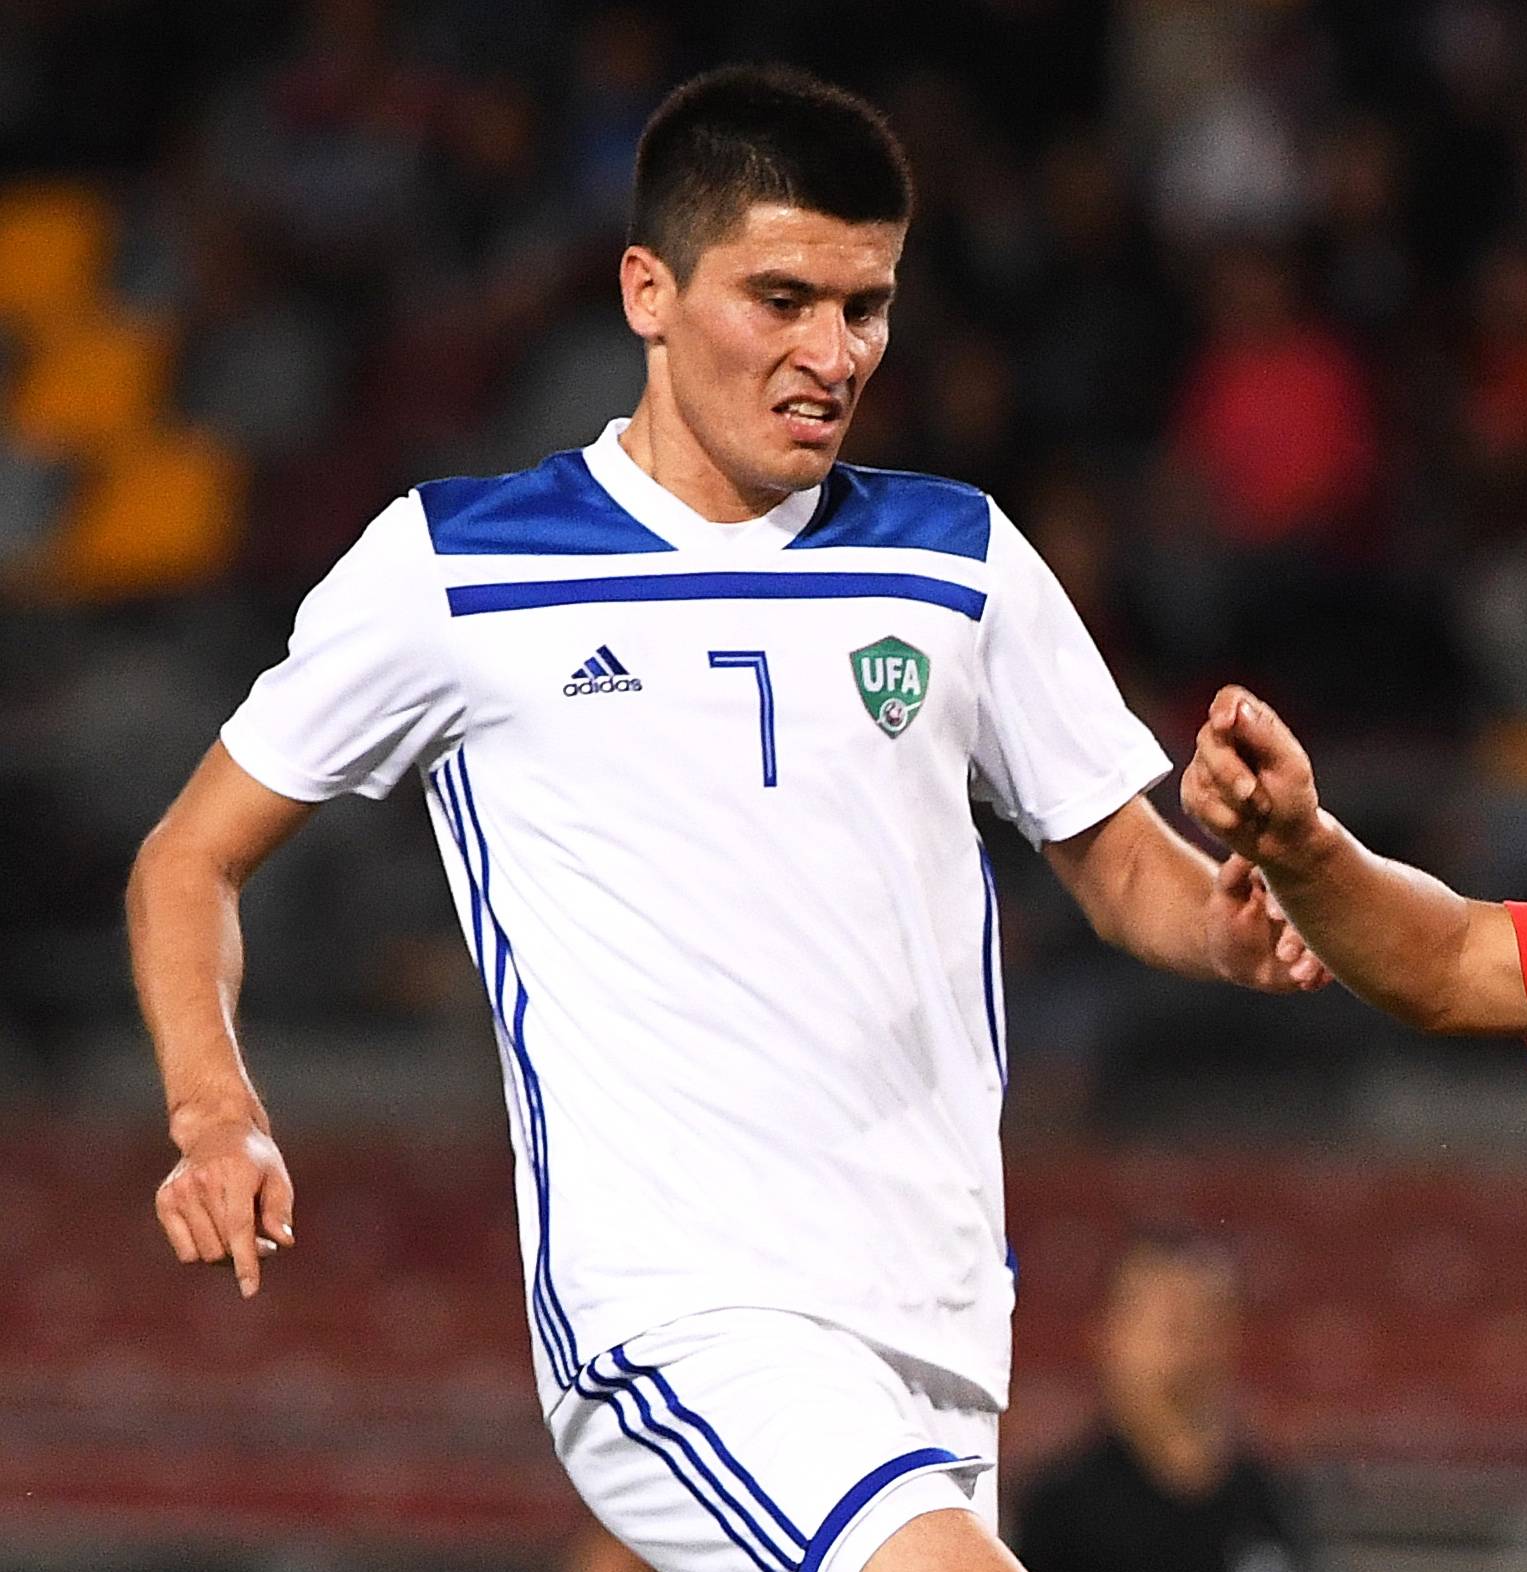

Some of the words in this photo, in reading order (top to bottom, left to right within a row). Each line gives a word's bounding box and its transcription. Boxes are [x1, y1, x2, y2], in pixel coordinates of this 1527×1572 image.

[562, 677, 643, 698] adidas
[861, 656, 921, 696] UFA
[707, 650, 778, 788] 7
